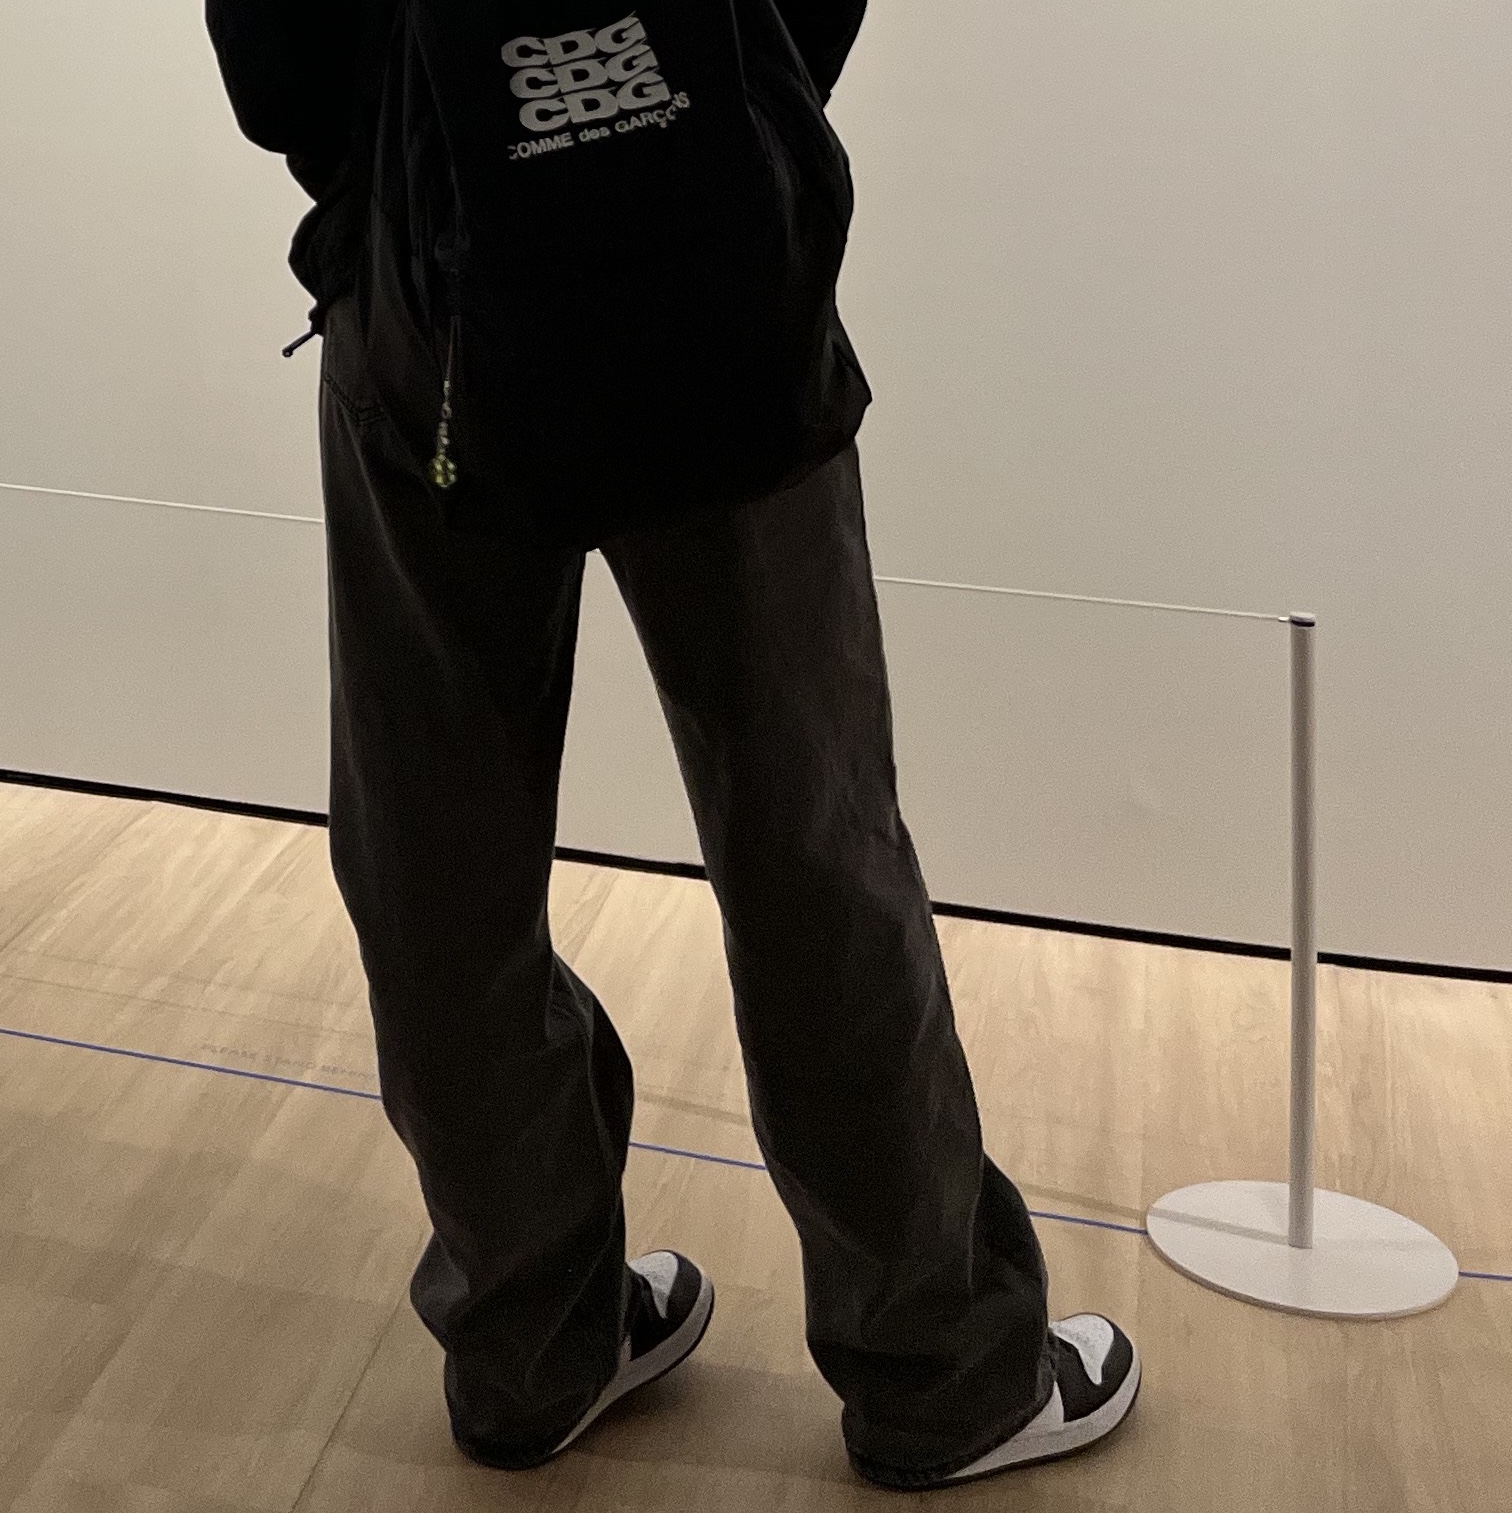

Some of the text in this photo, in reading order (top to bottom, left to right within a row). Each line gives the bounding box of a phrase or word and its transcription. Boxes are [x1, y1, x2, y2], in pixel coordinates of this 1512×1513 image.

[501, 10, 647, 68] CDG
[509, 38, 659, 99] CDG
[518, 66, 671, 132] CDG
